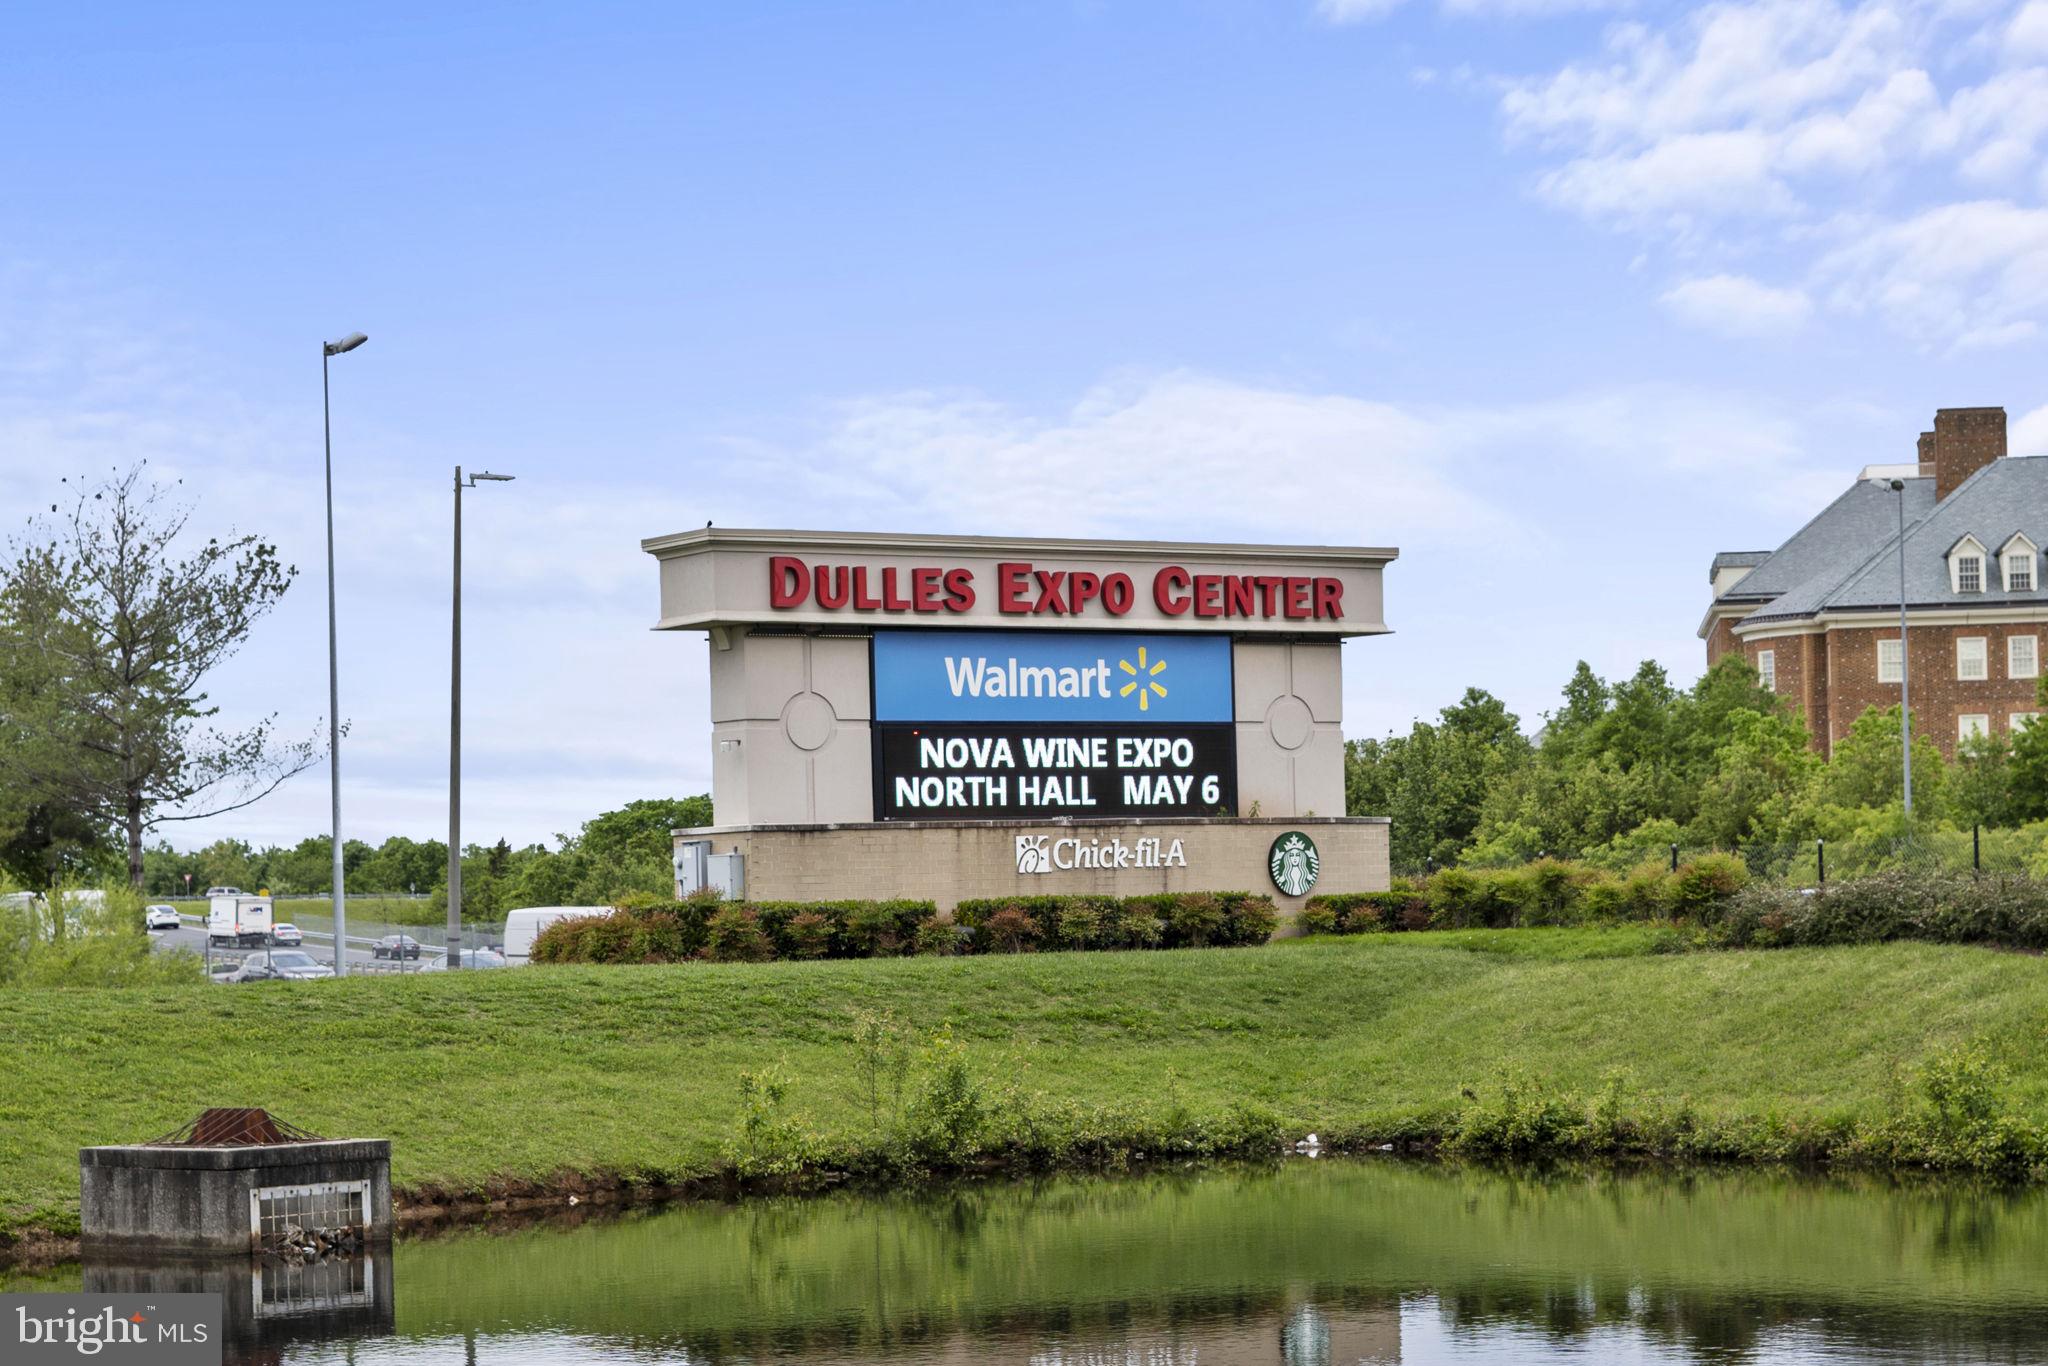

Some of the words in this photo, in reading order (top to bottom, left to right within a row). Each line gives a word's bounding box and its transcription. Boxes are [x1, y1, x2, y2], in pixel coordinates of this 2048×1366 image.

[998, 562, 1135, 615] EXPO
[1153, 565, 1344, 619] CENTER
[944, 656, 1111, 698] Walmart
[920, 738, 1015, 768] NOVA
[1023, 738, 1108, 768] WINE
[1117, 738, 1193, 768] EXPO
[895, 776, 1007, 807] NORTH
[1019, 776, 1096, 806] HALL
[1123, 775, 1193, 805] MAY
[1201, 775, 1220, 804] 6
[1053, 838, 1187, 869] Chick-fil-A
